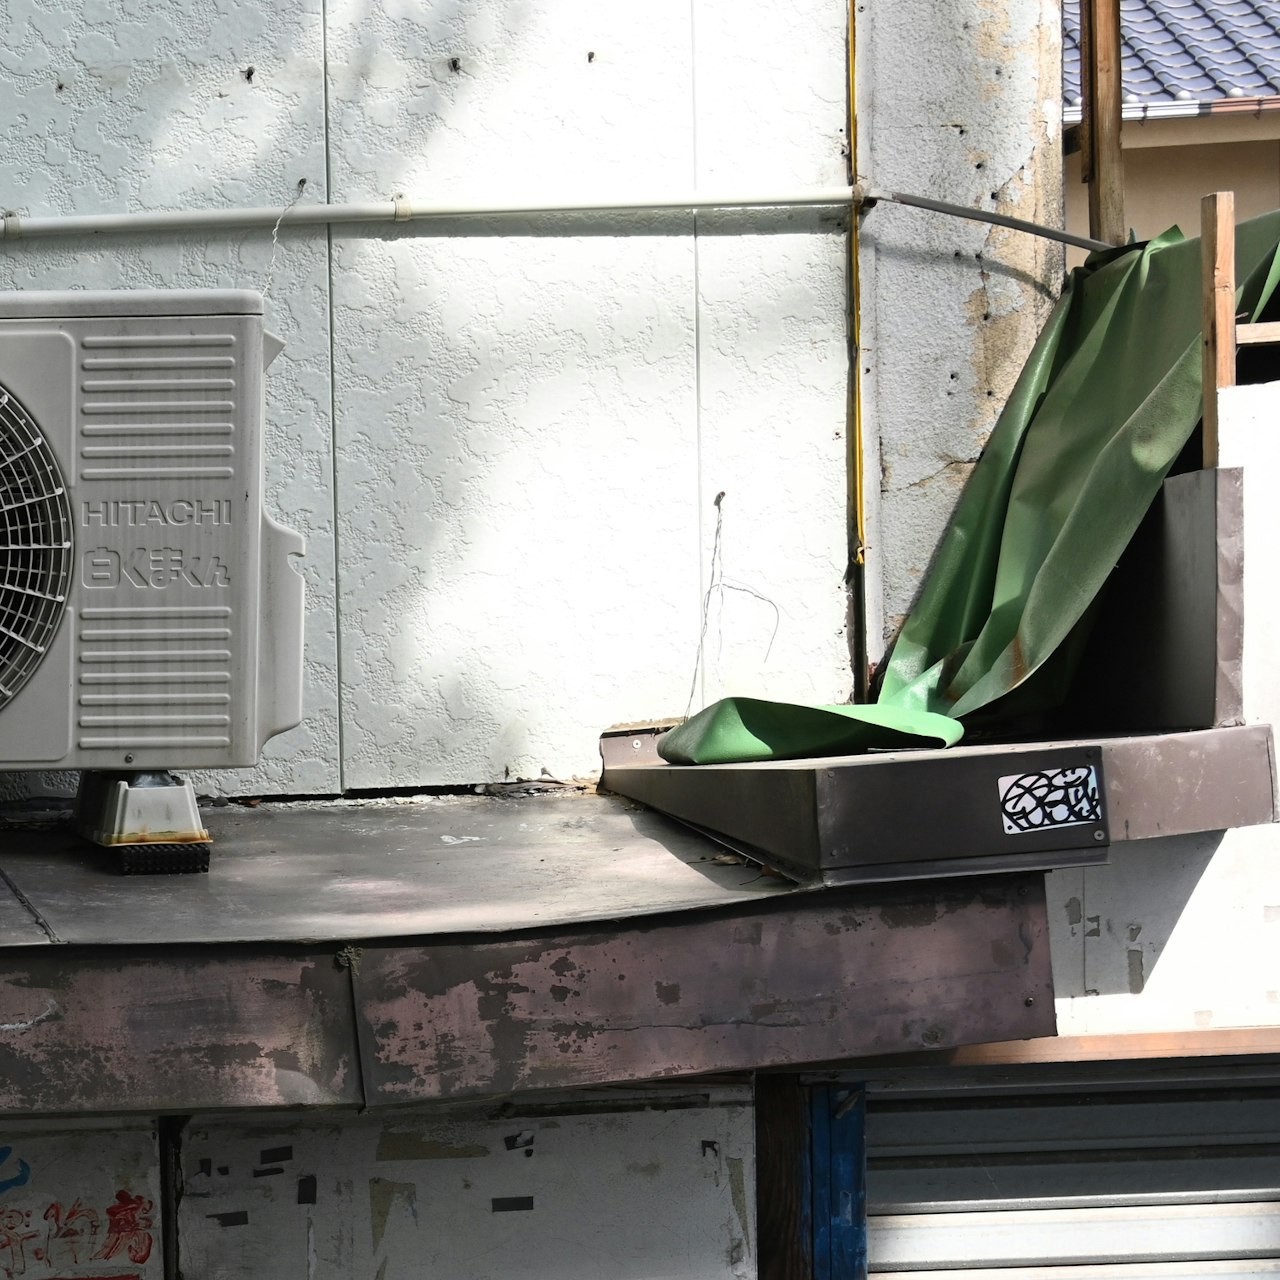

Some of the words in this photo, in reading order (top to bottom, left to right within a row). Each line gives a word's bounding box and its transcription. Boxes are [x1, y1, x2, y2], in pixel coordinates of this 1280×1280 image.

[81, 499, 232, 527] HITACHI
[81, 546, 231, 590] 白くまくん
